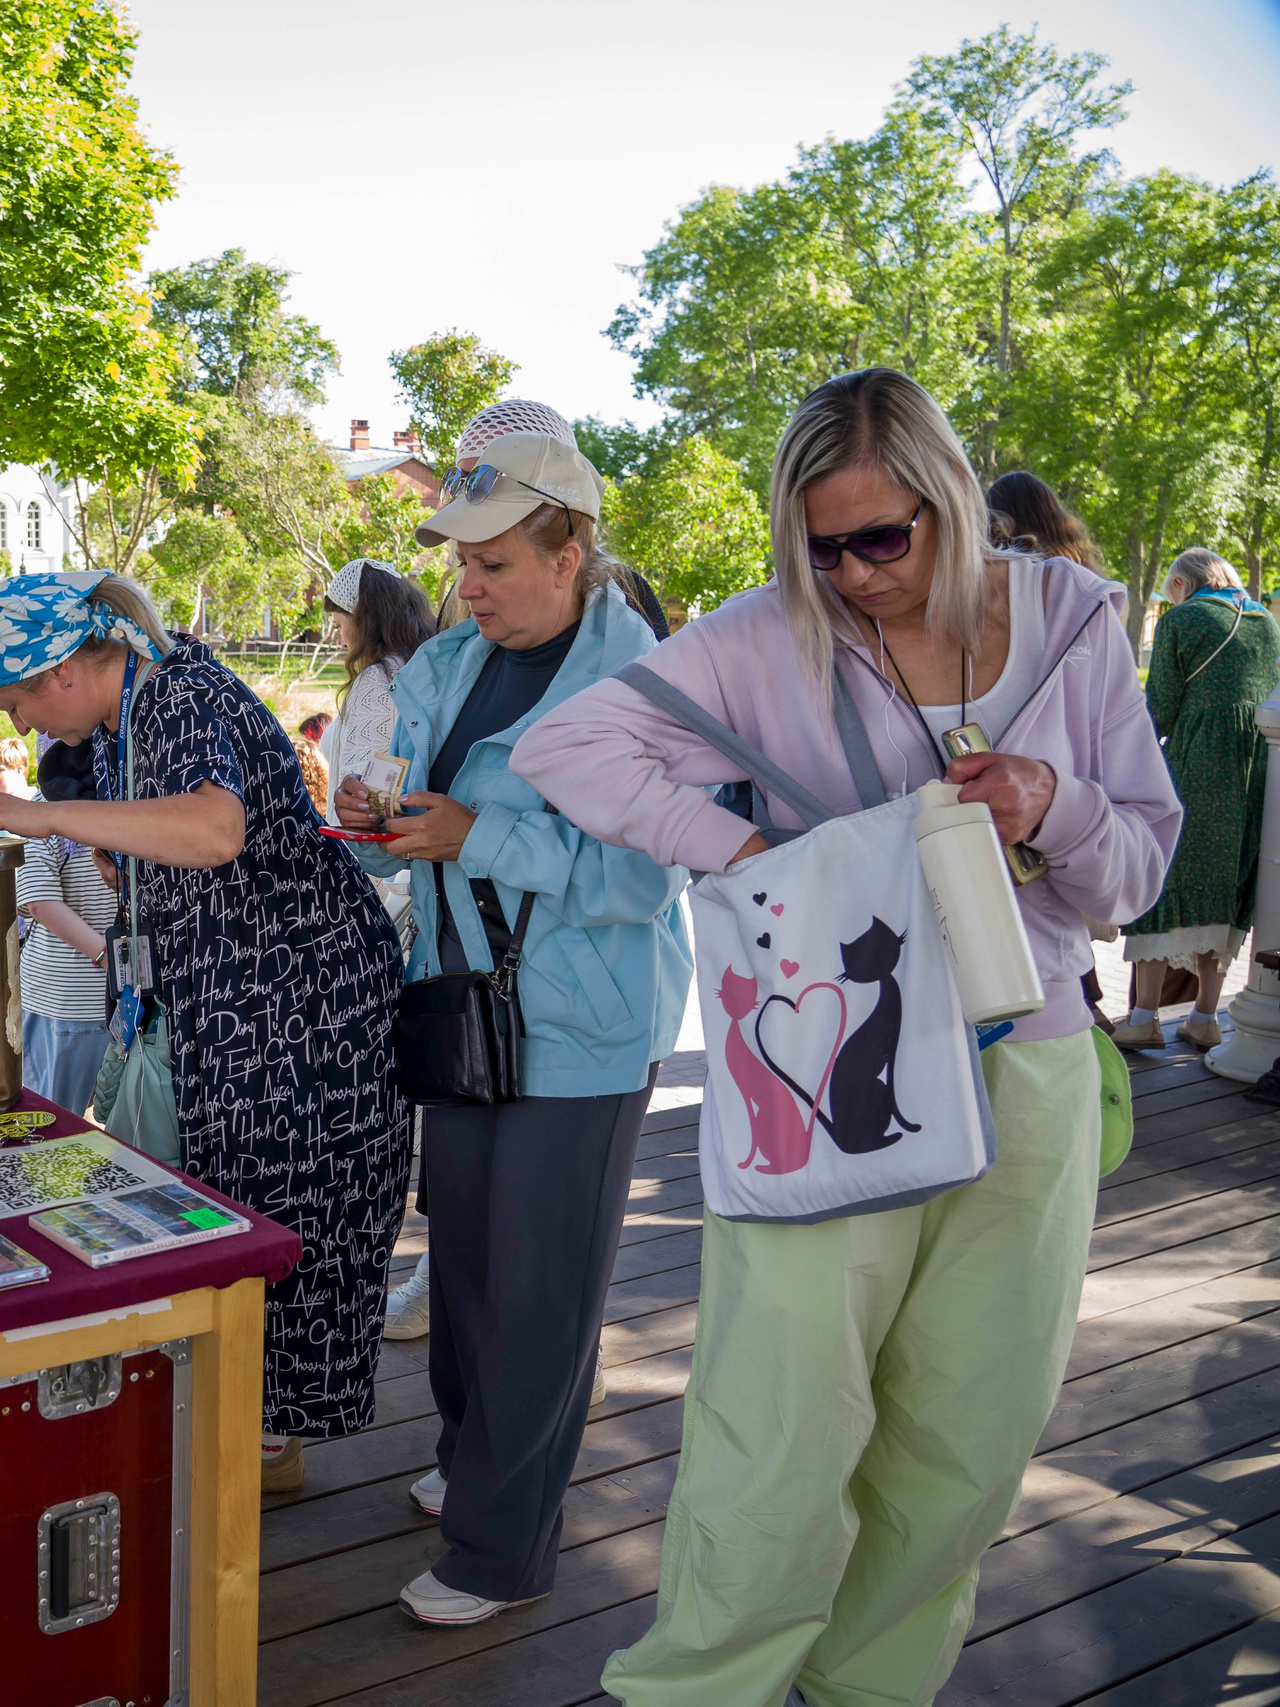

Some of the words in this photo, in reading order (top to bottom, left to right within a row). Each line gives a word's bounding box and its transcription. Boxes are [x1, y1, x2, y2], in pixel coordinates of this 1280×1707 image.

[119, 696, 129, 740] СОЗВЕЗДИЕ
[198, 969, 234, 1012] Huh
[221, 1083, 254, 1134] Gee
[238, 1110, 272, 1152] Huh
[271, 1312, 307, 1349] Huh
